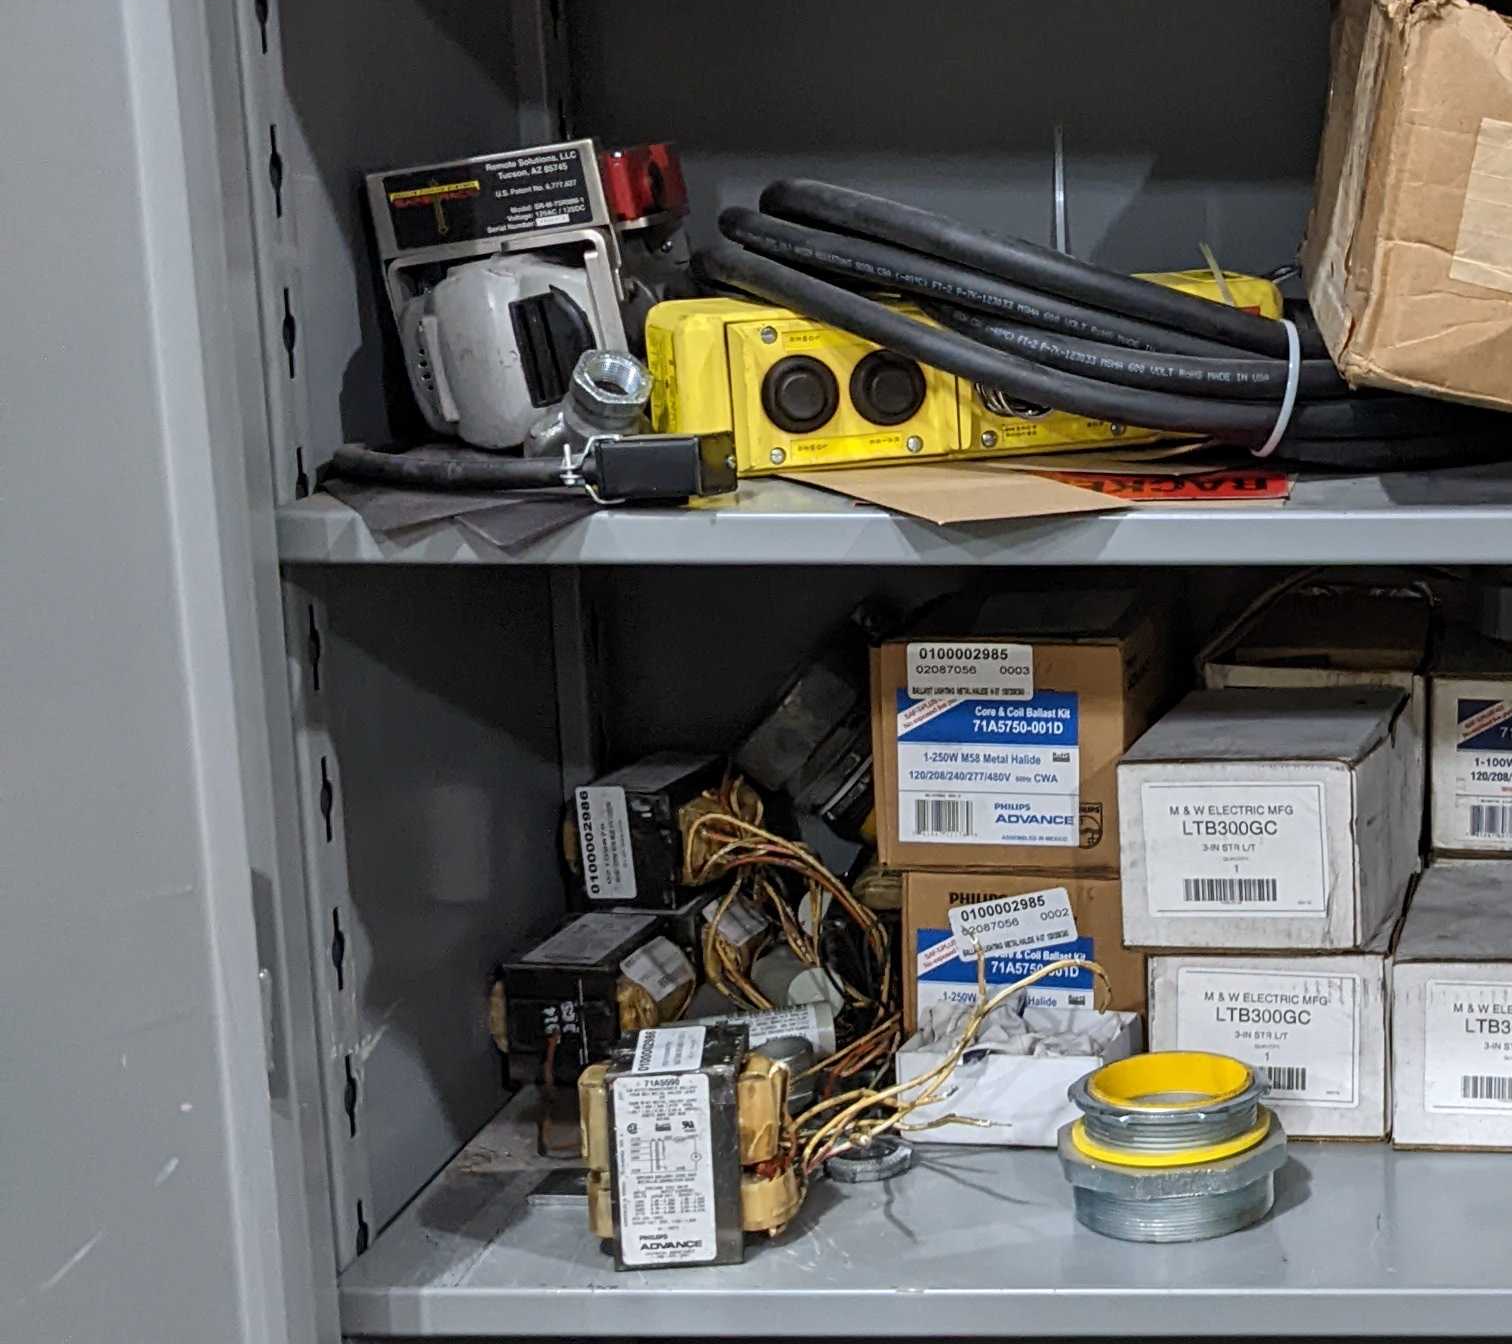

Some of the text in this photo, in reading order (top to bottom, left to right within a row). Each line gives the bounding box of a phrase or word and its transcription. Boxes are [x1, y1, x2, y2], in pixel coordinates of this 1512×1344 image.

[486, 161, 516, 171] Remote
[560, 151, 576, 160] LLC
[531, 166, 542, 174] AZ
[1150, 362, 1172, 376] VOLT
[1207, 371, 1231, 382] MADE
[1236, 372, 1248, 382] IN
[920, 648, 1008, 660] 0100002985
[916, 665, 1030, 675] 02087056 0003
[975, 706, 1071, 718] Core & Coil Ballast Kit
[973, 720, 1063, 735] 71A5750-001D
[924, 752, 1041, 765] 1-250W M58 Metal Halide
[1034, 774, 1058, 783] CWA
[994, 803, 1031, 811] PHILIPS
[1170, 805, 1294, 815] M & W ELECTRIC MFG
[995, 814, 1074, 825] ADVANCE
[1182, 820, 1278, 836] LTB300GC
[578, 789, 602, 895] 0100002986
[961, 896, 1045, 922] 0100002985
[1040, 908, 1069, 921] 0002
[1204, 992, 1328, 1006] M & W ELECTRIC MFG
[1453, 1002, 1464, 1013] M
[1467, 1003, 1475, 1013] &
[1478, 1003, 1489, 1014] W
[1215, 1006, 1312, 1025] LTB300GC
[640, 1240, 702, 1250] ADVANCE
